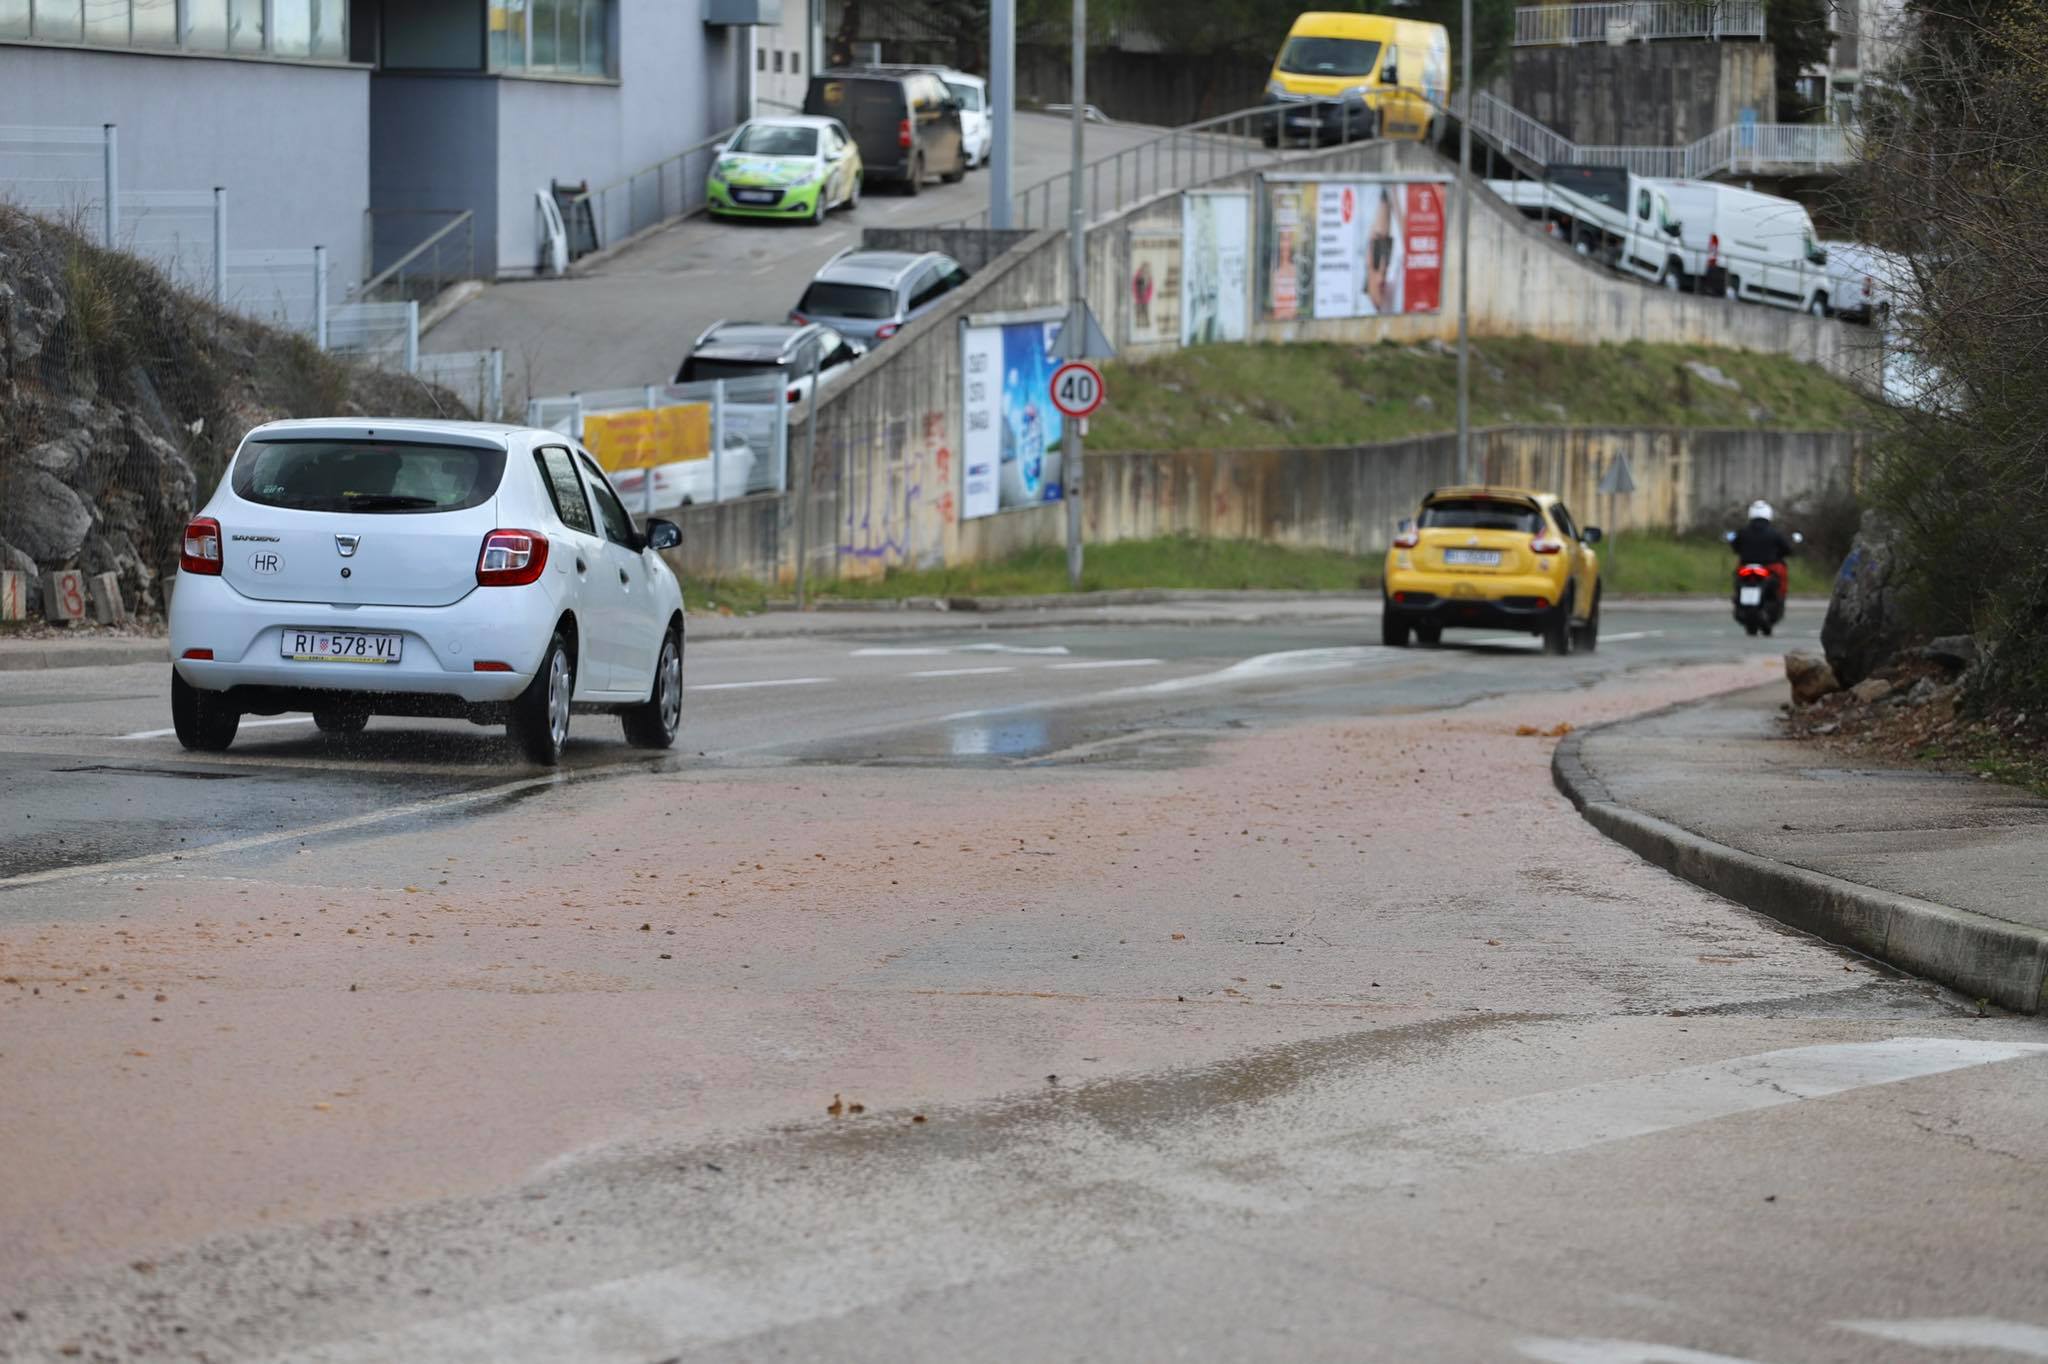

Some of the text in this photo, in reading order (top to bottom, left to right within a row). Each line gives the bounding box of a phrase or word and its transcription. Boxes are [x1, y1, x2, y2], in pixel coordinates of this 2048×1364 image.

[1060, 369, 1092, 402] 40
[255, 554, 278, 572] HR
[295, 634, 396, 656] RI 578-VL
